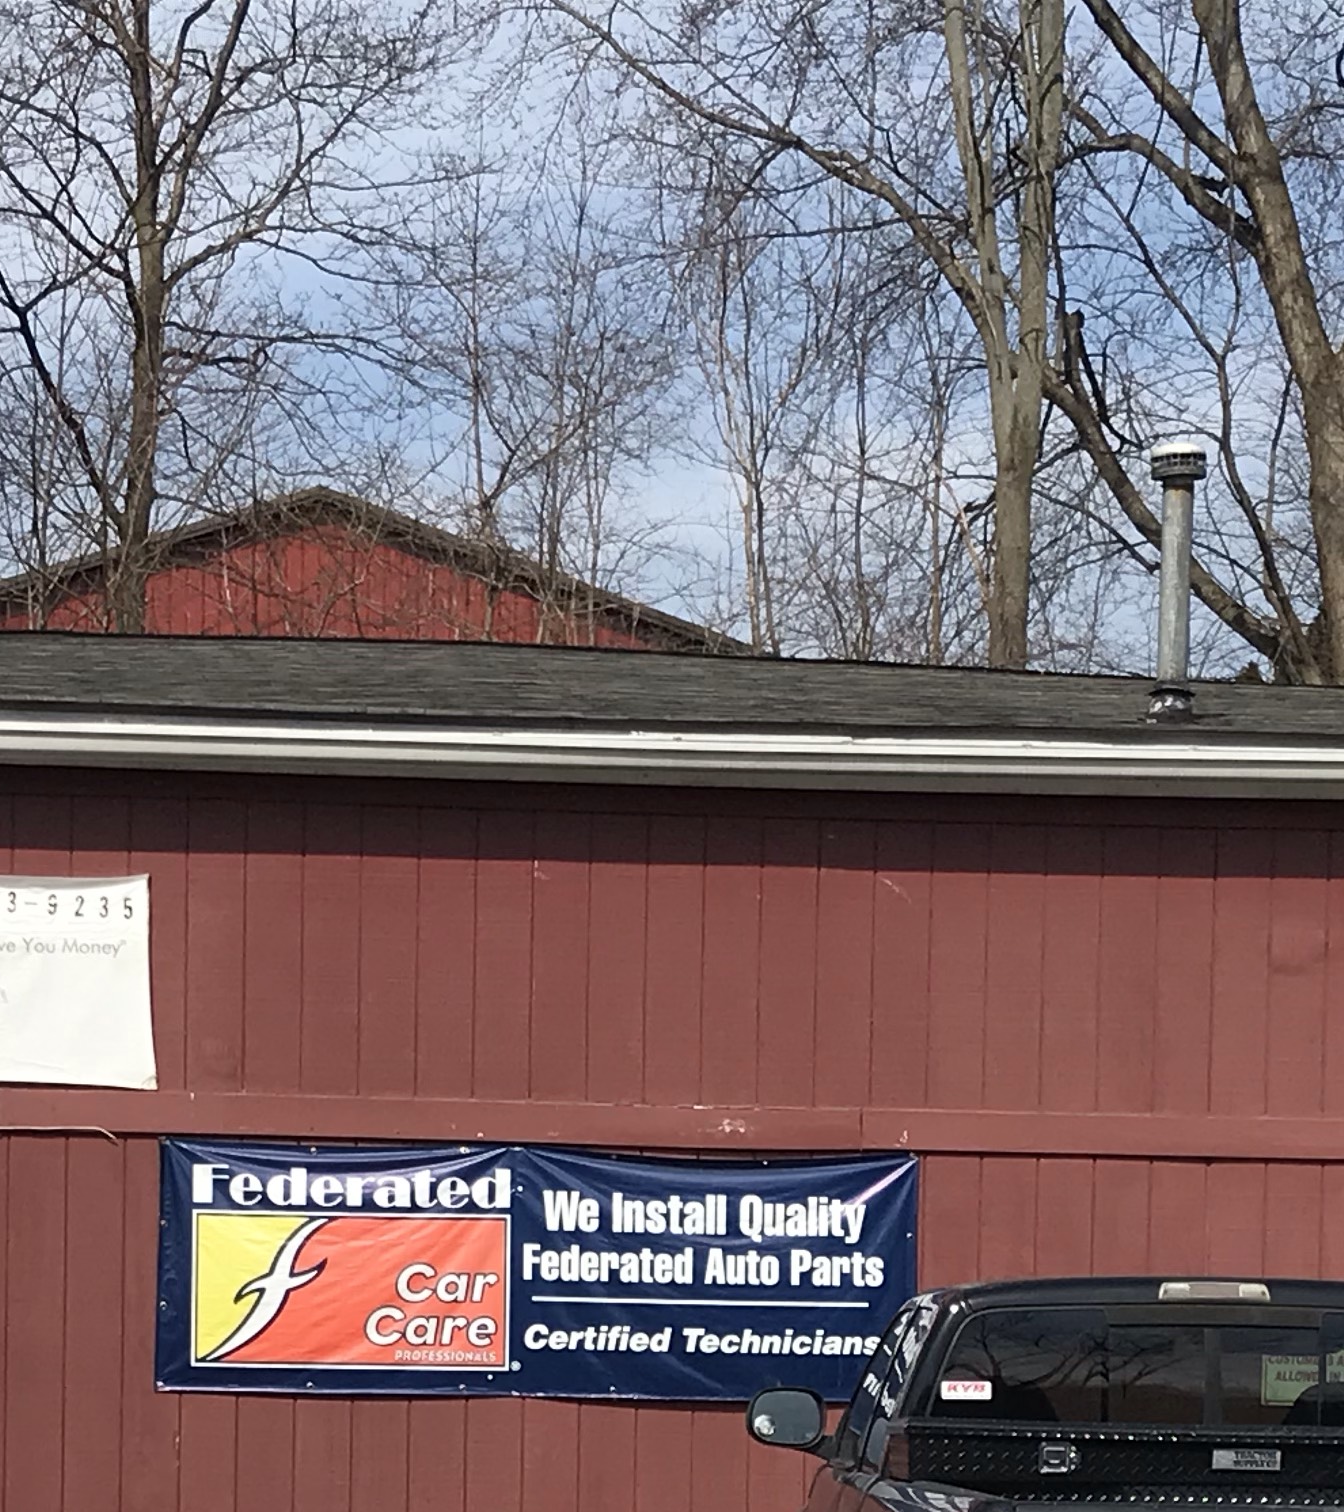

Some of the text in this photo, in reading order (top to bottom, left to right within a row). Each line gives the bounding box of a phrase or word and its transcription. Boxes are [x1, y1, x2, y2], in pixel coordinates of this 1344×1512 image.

[22, 938, 56, 953] You
[192, 1163, 512, 1208] Federated
[543, 1189, 867, 1244] We Install Quality
[395, 1262, 499, 1303] Car
[522, 1242, 885, 1288] Federated Auto Parts
[364, 1305, 497, 1348] Care
[524, 1323, 880, 1357] Certified Technicians
[394, 1350, 497, 1363] PROFESSIONALS
